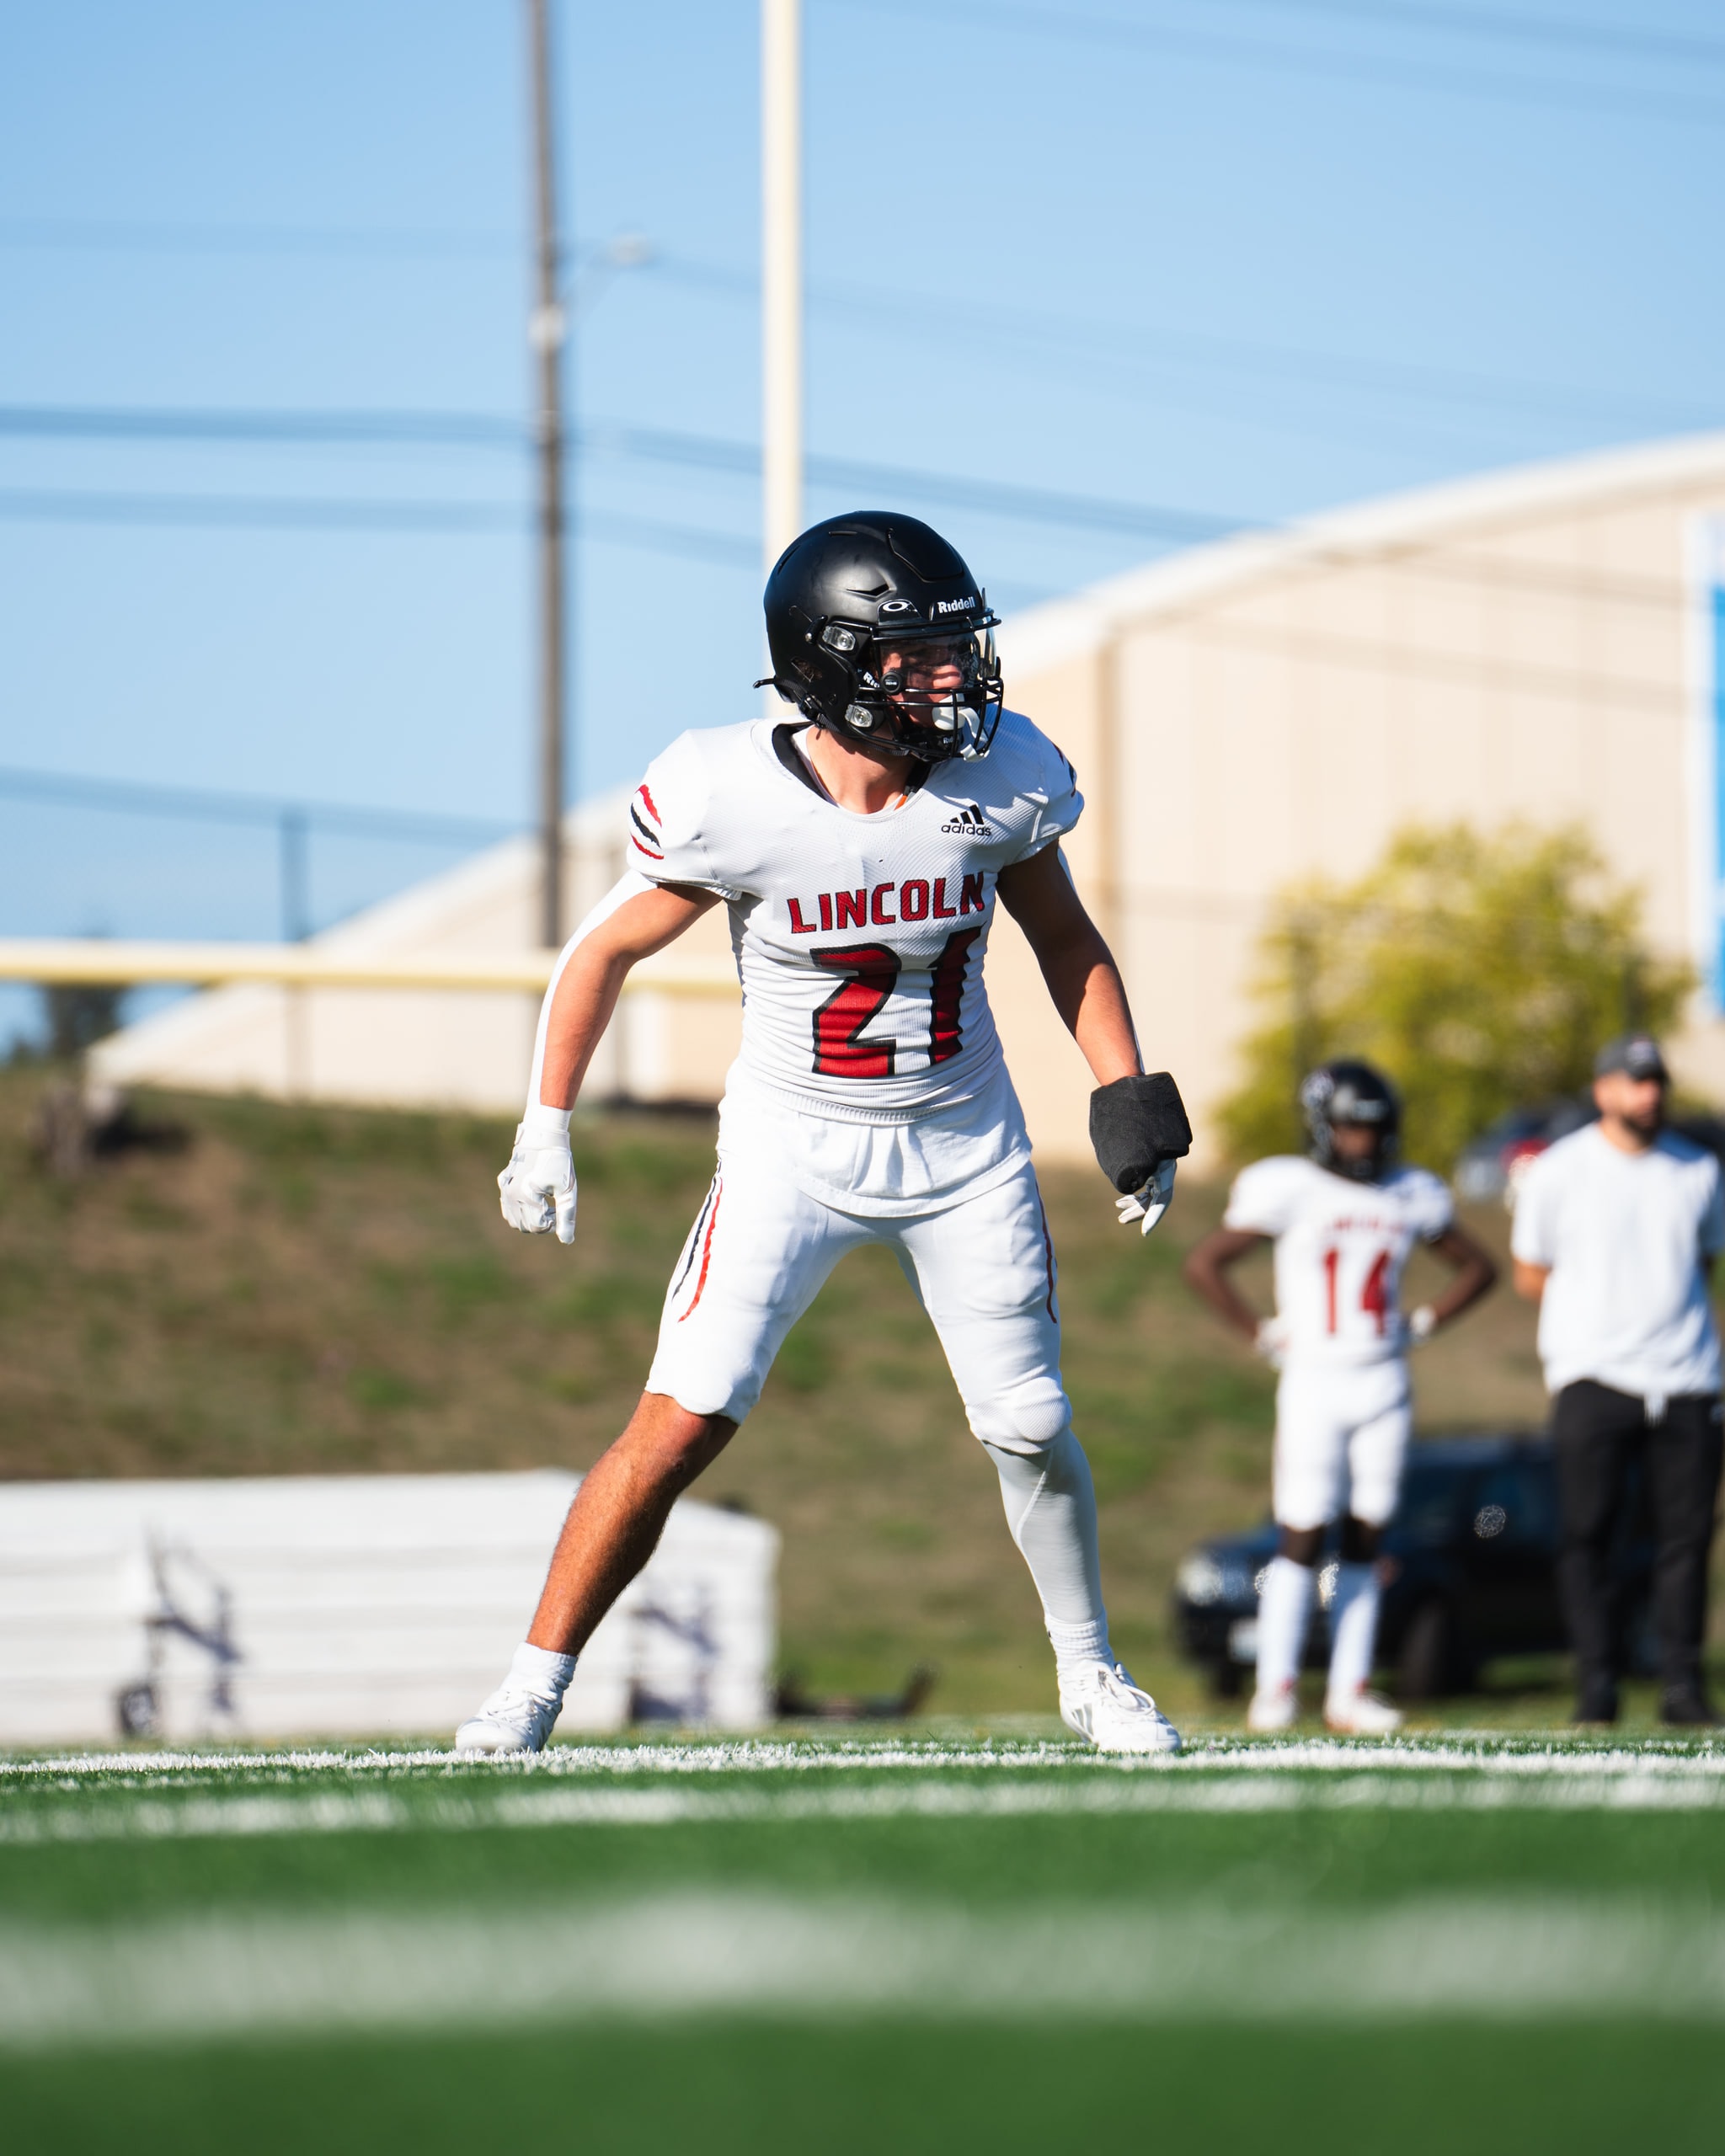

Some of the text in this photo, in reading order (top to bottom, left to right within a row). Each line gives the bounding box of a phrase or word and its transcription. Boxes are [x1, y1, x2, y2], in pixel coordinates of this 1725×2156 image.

[937, 596, 975, 613] Riddell
[941, 823, 991, 835] adidas
[788, 872, 985, 933] LINCOLN
[809, 925, 984, 1078] 21
[1322, 1246, 1391, 1337] 14
